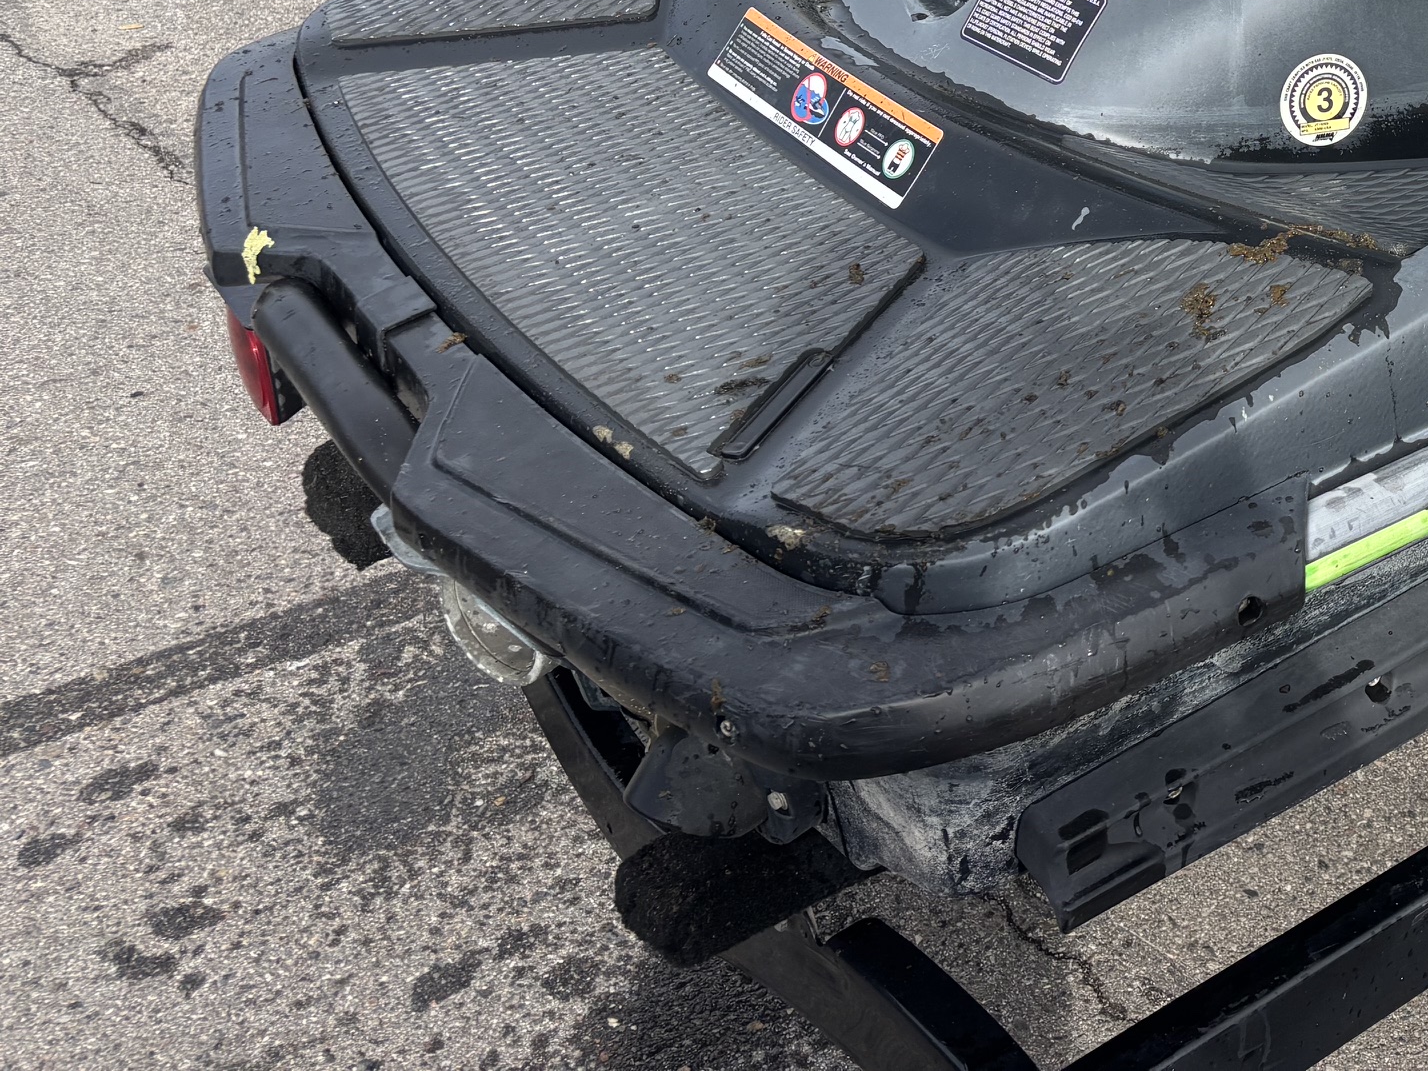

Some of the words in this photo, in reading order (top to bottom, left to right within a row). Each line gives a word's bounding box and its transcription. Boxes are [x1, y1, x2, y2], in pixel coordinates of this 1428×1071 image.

[814, 56, 848, 82] WARNING
[1316, 87, 1334, 113] 3
[773, 112, 792, 129] RIDER
[791, 125, 815, 145] SAFETY
